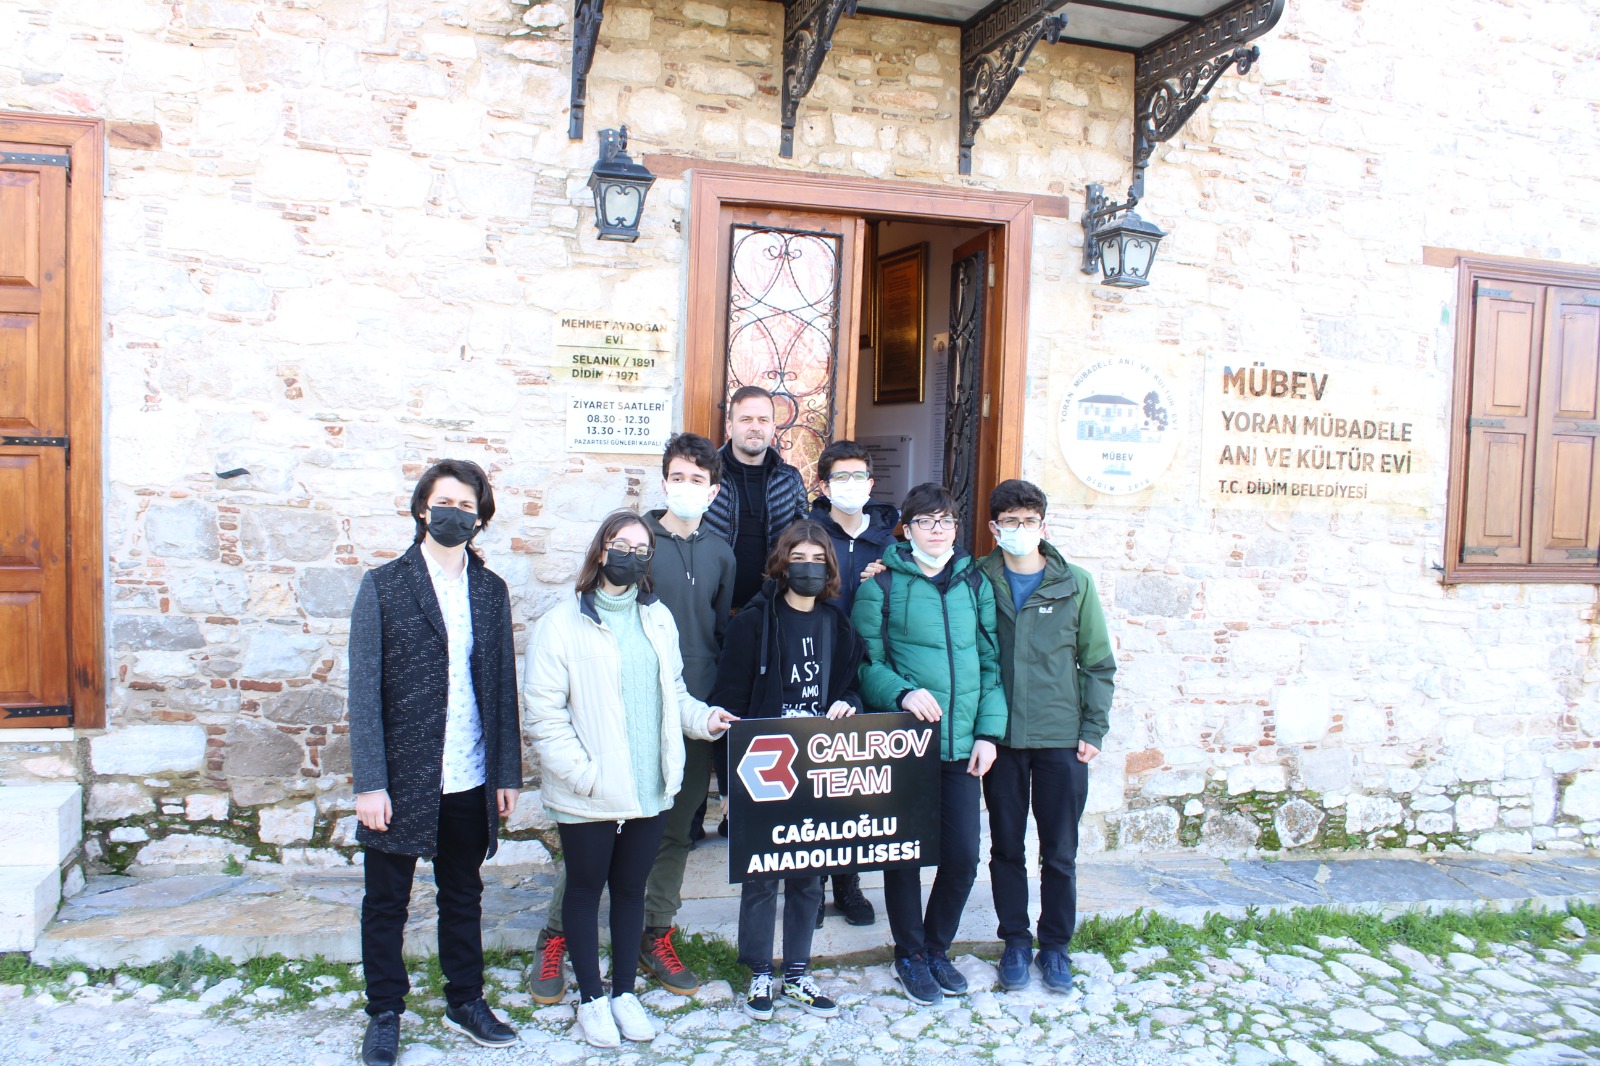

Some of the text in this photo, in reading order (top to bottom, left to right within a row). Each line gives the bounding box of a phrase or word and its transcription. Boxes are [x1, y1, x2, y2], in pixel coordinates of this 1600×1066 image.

[561, 318, 668, 333] MEHMET AYDOĞAN
[605, 334, 624, 345] EVİ
[572, 354, 655, 368] SELANİK / 1891
[571, 367, 604, 379] DİDİM
[616, 370, 639, 381] 1971
[1222, 361, 1329, 401] MÜBEV
[1060, 391, 1075, 423] YORAN
[1118, 357, 1134, 366] ANI
[1140, 363, 1151, 374] VE
[573, 399, 665, 411] ZİYARET SAATLERİ
[587, 414, 616, 424] 08.30
[625, 415, 650, 425] 12.30
[1221, 410, 1413, 442] YORAN MÜBADELE
[587, 426, 614, 435] 13.30
[625, 427, 650, 436] 17.30
[574, 438, 610, 446] PAZARTESİ
[1102, 451, 1134, 461] MÜBEV
[1219, 445, 1412, 474] ANI VE KÜLTÜR EVİ
[1218, 478, 1368, 499] T.C. DİDİM BELEDİYESİ
[802, 685, 819, 698] AMO
[807, 728, 932, 763] CALROV
[807, 765, 891, 799] TEAM
[772, 813, 898, 845] CAĞALOĞLU
[747, 846, 852, 874] ANADOLU
